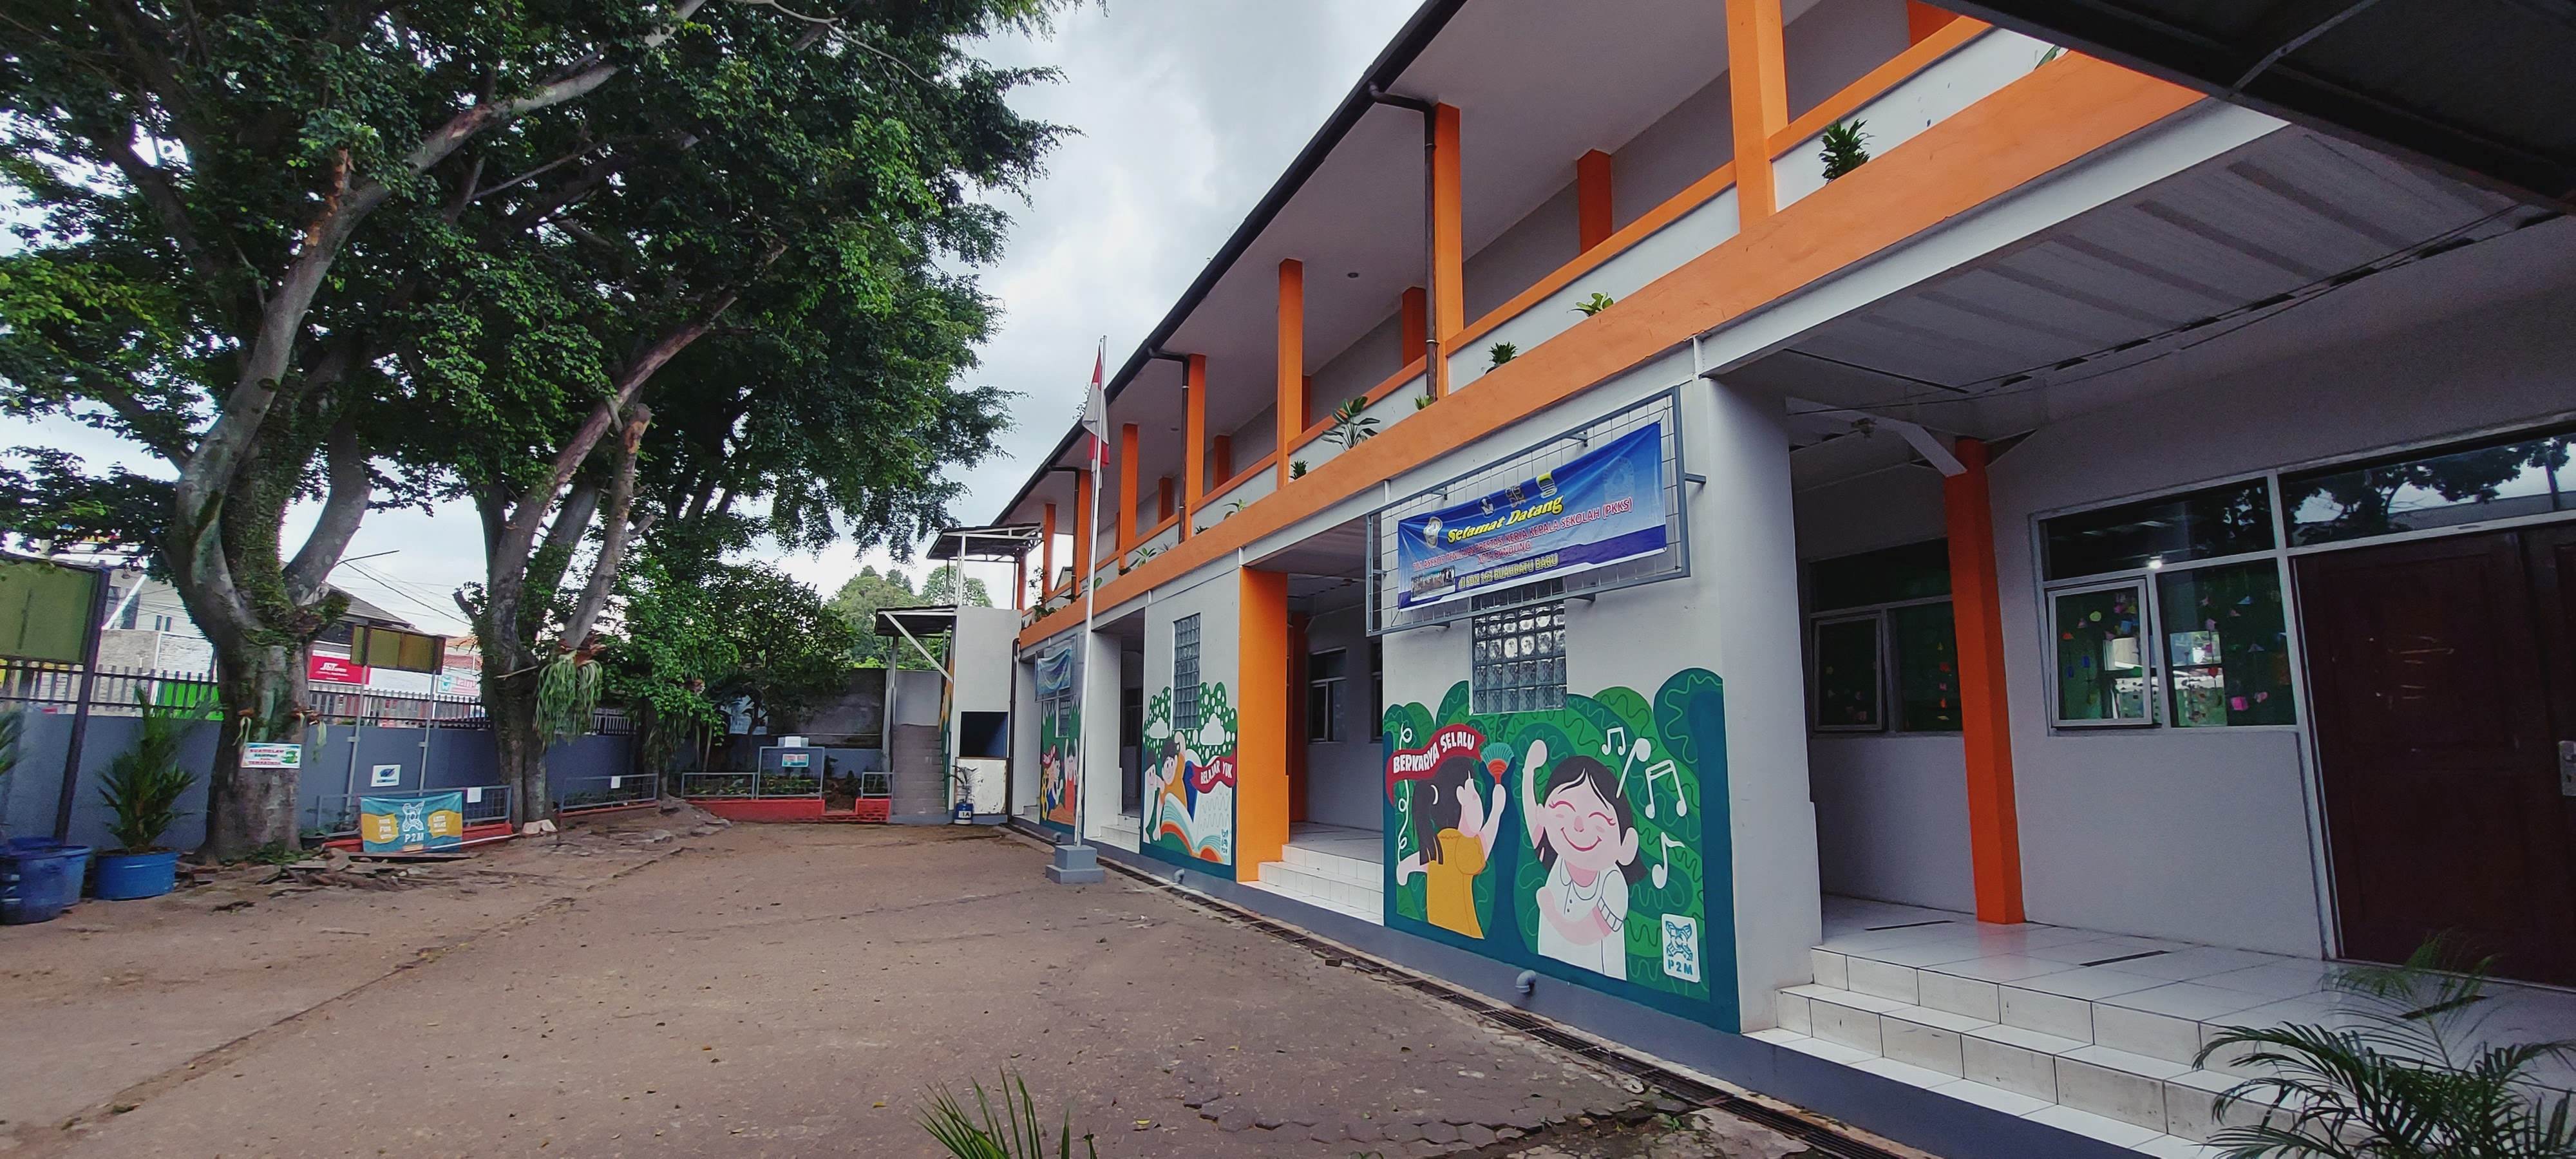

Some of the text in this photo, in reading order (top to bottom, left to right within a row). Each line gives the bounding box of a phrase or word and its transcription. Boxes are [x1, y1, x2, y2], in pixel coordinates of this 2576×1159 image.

[1448, 495, 1564, 543] Selamat Datang
[1474, 535, 1504, 551] PRESTASI
[1505, 529, 1528, 543] KERJA
[1529, 520, 1559, 538] KEPALA
[1560, 507, 1600, 529] SEKOLAH
[1602, 496, 1633, 519] (PKKS)
[1494, 540, 1531, 560] BANDUNG
[1466, 573, 1481, 587] SDN
[1493, 559, 1534, 580] BUAHBATU
[1535, 552, 1559, 570] BARU
[1393, 731, 1475, 773] BERKARYA SELALU
[1200, 760, 1233, 784] BELAJAR YUK
[404, 833, 424, 843] P2M
[1668, 959, 1693, 975] P2M
